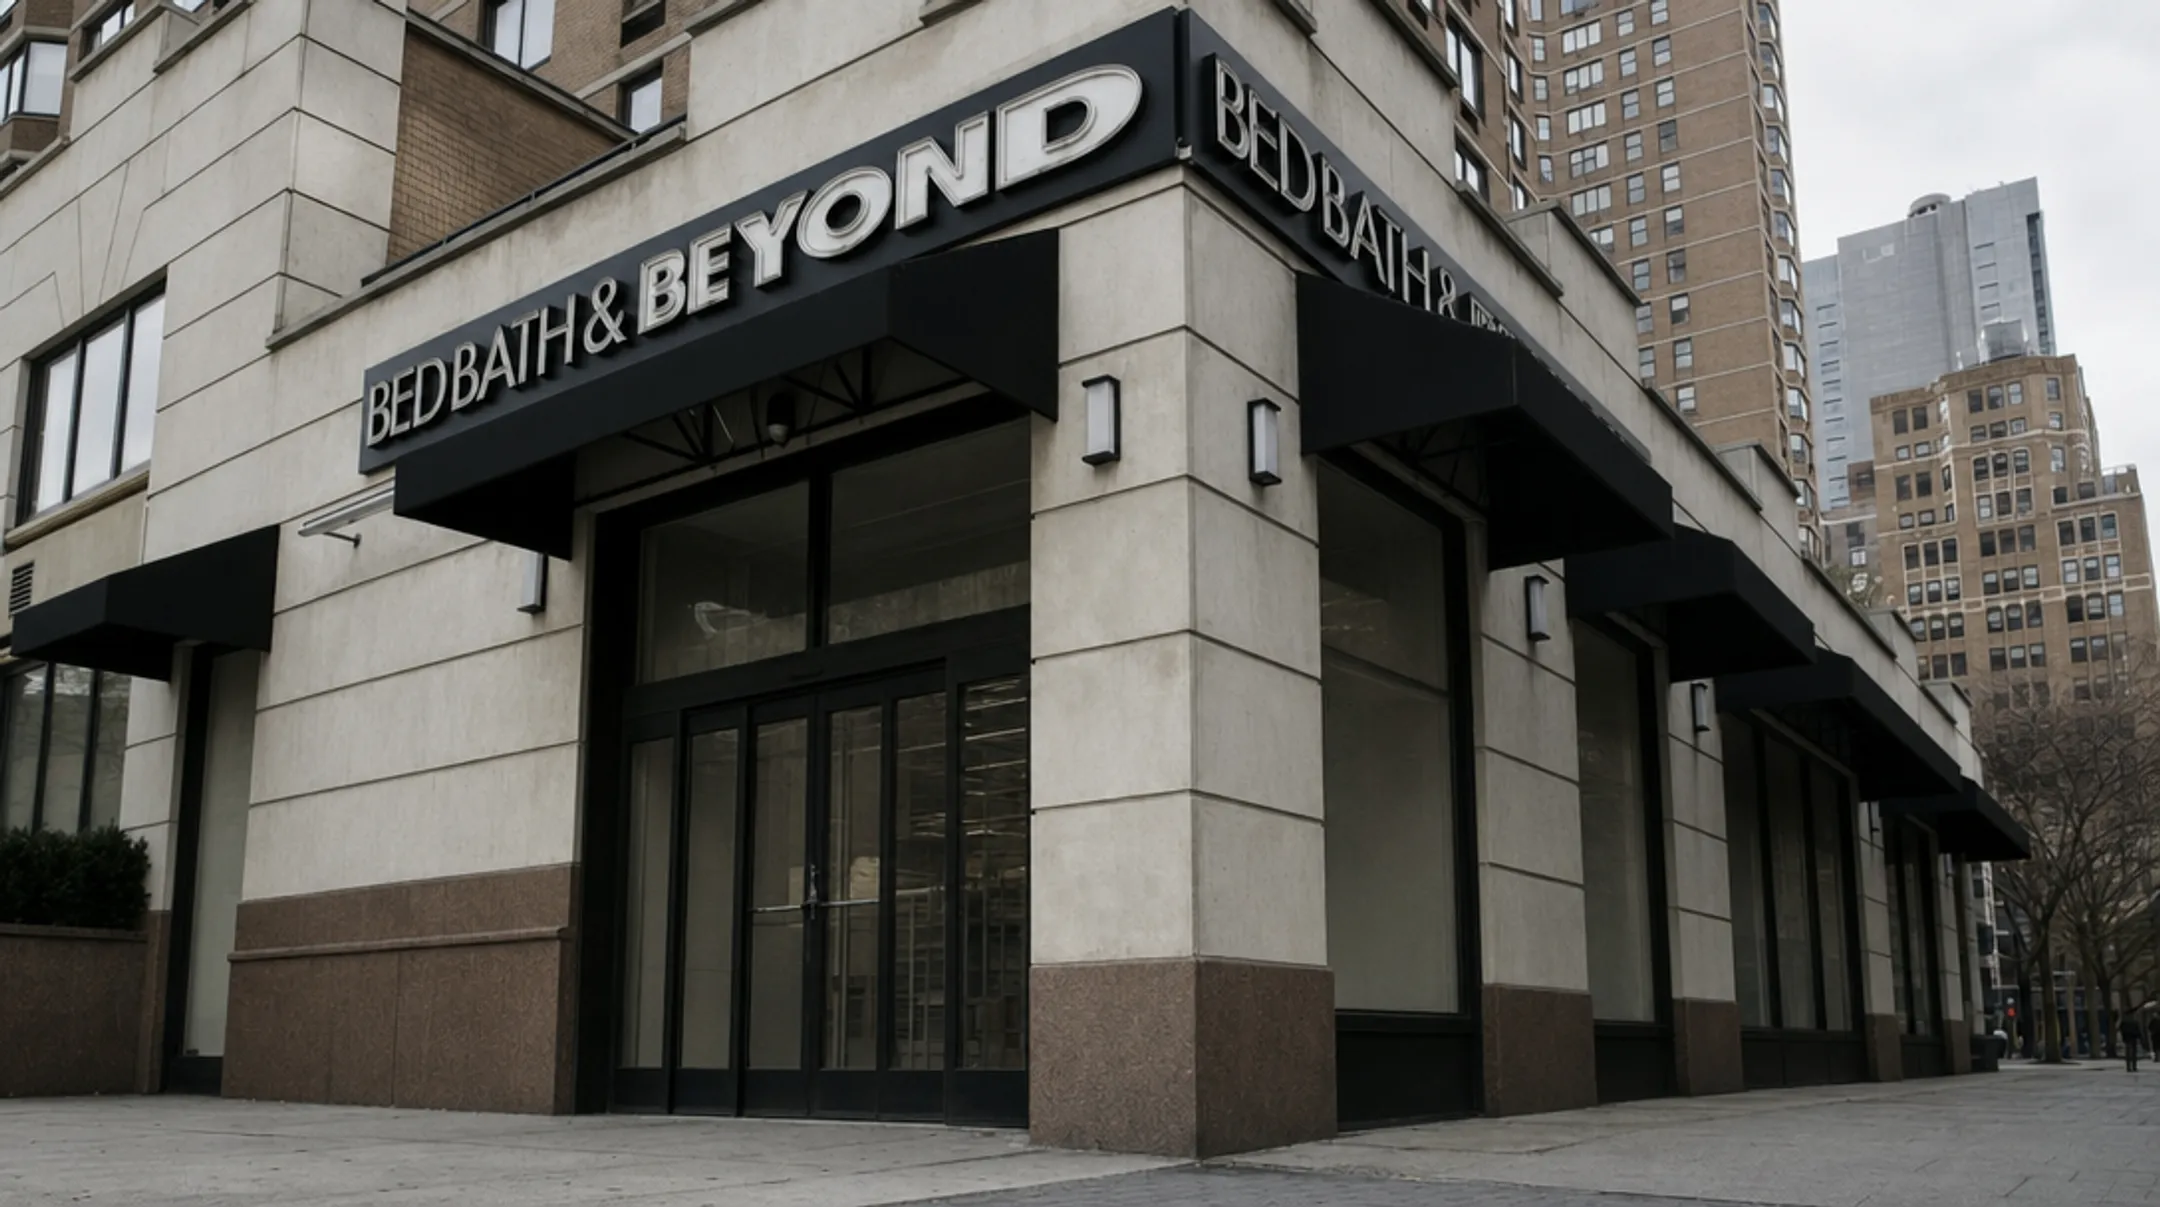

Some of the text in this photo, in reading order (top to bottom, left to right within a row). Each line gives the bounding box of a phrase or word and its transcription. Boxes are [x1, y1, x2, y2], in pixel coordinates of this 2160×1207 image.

[367, 63, 1143, 446] BED BATH & BEYOND
[1214, 58, 1458, 320] BED BATH &
